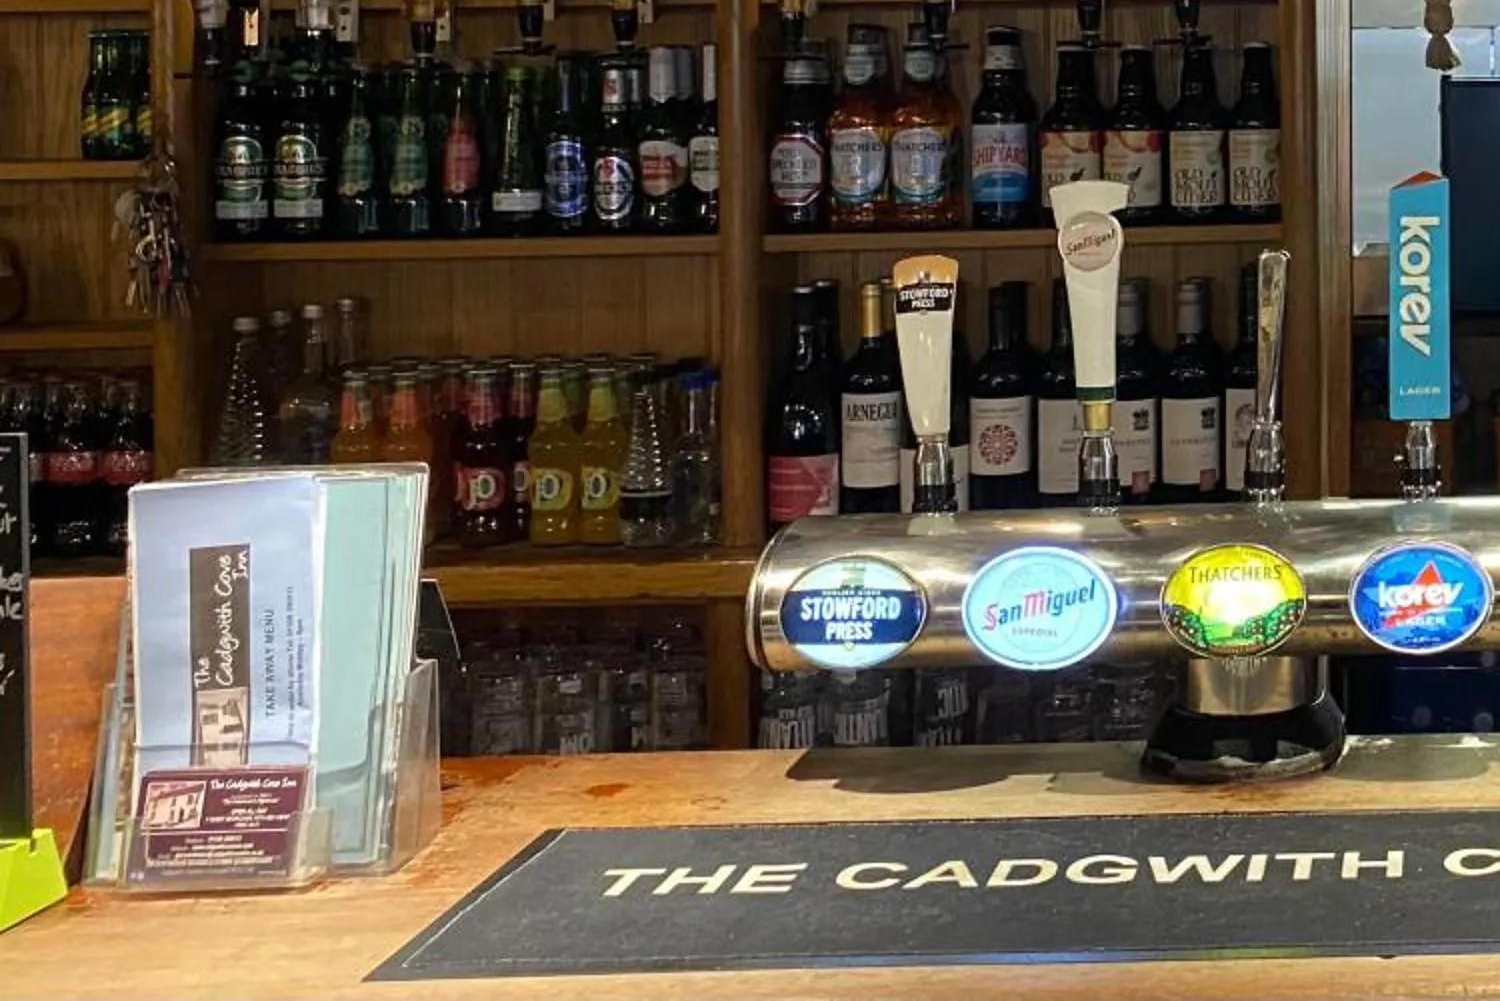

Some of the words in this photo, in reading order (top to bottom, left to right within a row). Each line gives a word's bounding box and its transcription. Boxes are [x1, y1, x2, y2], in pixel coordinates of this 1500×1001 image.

[900, 288, 949, 301] STOWFORD
[1399, 215, 1441, 358] korev
[911, 299, 936, 309] PRESS
[1399, 385, 1441, 397] LAGER
[213, 553, 233, 597] Cove
[231, 549, 249, 579] Inn
[1187, 564, 1283, 584] THATCHERS
[800, 596, 901, 622] STOWFORD
[1377, 581, 1465, 609] korev
[263, 608, 276, 644] MENU
[824, 621, 874, 642] PRESS
[1011, 628, 1059, 639] ESPECIAL
[213, 599, 240, 687] Cadgwith
[194, 655, 212, 689] The
[264, 645, 276, 683] AWAY
[264, 685, 276, 719] TAKE
[601, 863, 809, 898] THE
[834, 849, 1404, 892] CADGWITH
